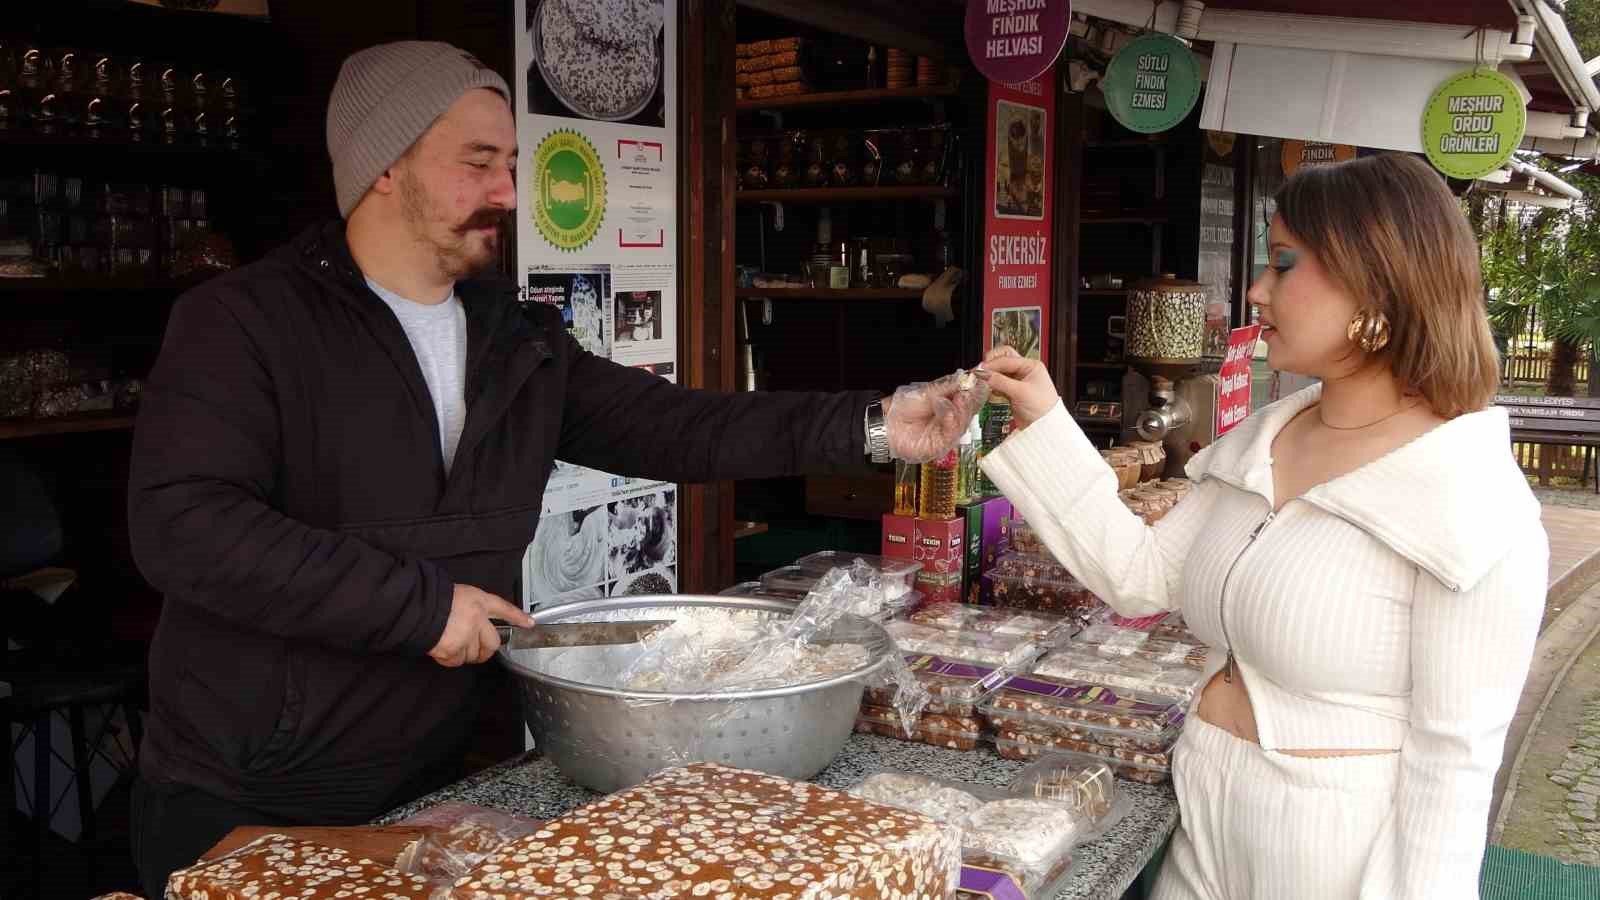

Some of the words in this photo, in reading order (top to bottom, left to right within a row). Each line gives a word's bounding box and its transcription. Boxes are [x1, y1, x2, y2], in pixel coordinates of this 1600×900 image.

[993, 15, 1039, 35] FINDIK
[986, 36, 1043, 58] HELVASI
[1136, 74, 1166, 90] FINDIK
[1448, 96, 1504, 115] MEŞHUR
[1453, 116, 1492, 132] ORDU
[1440, 133, 1499, 153] ÜRÜNLERİ
[1301, 149, 1335, 162] FINDIK
[990, 231, 1047, 272] ŞEKERSİZ
